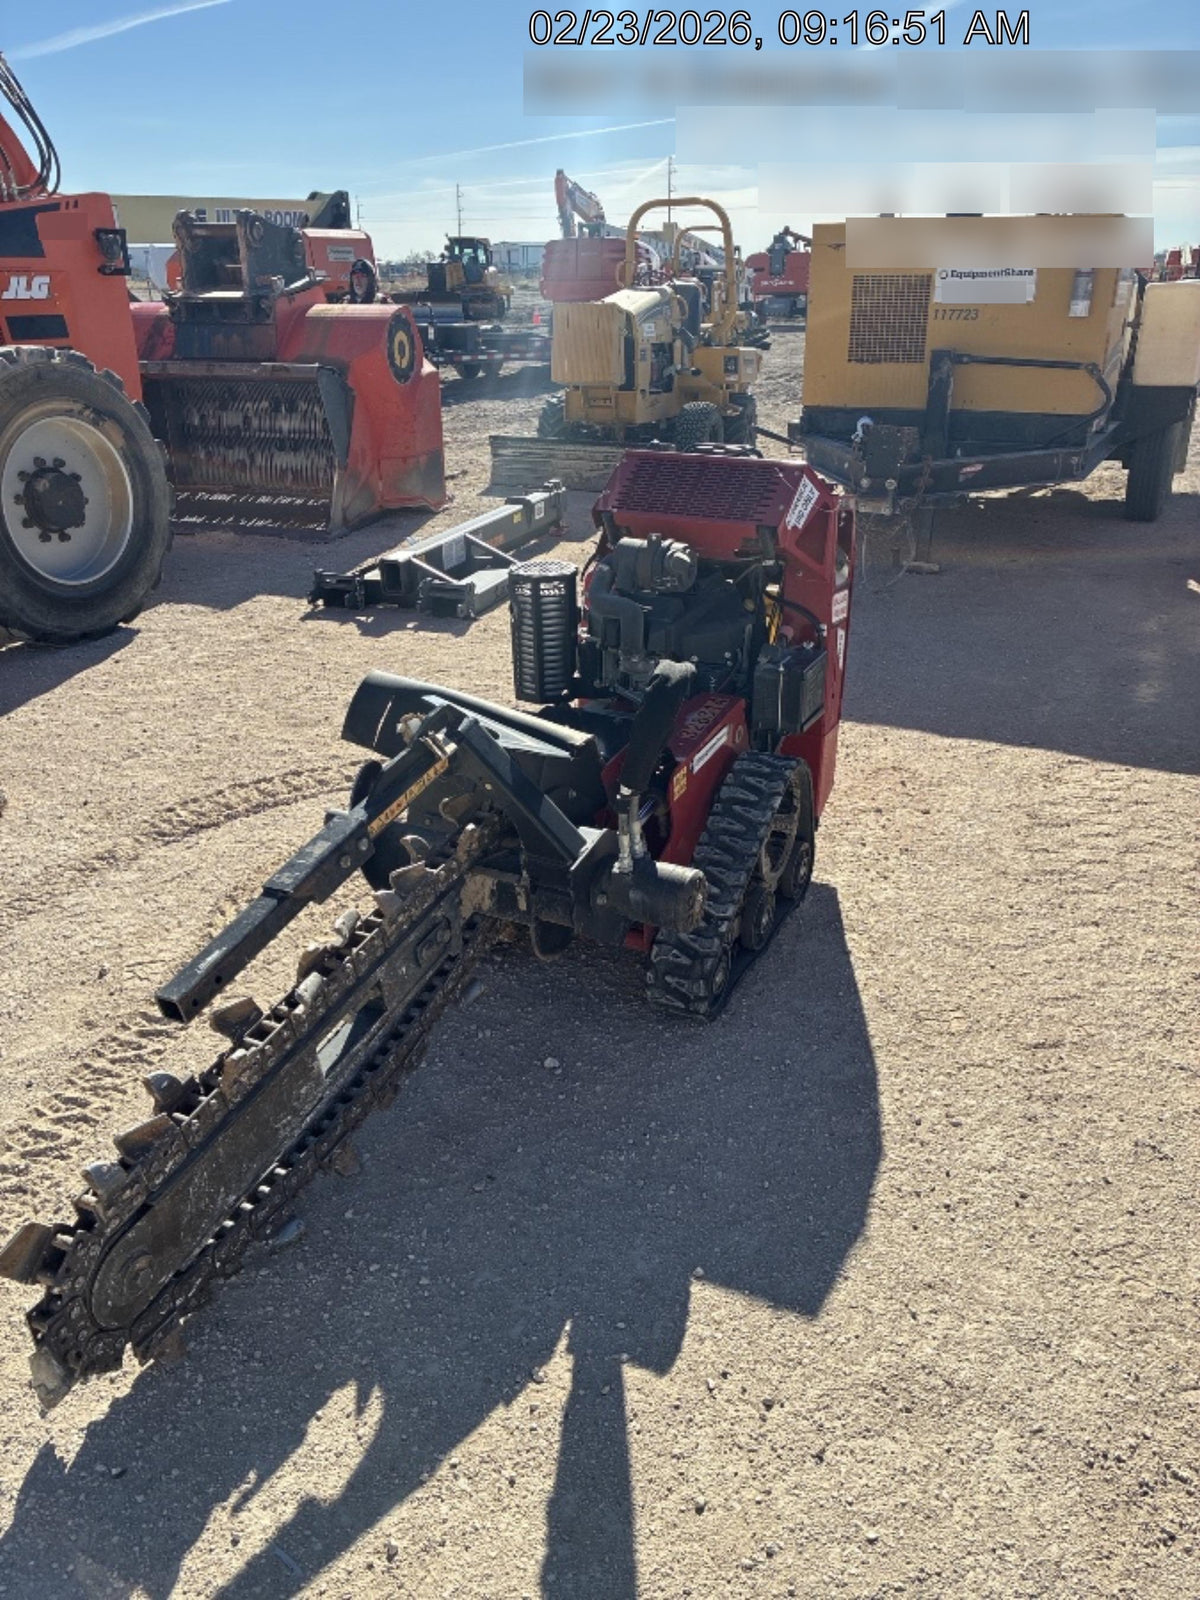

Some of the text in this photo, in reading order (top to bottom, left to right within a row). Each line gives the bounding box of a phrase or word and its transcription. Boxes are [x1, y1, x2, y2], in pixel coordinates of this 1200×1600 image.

[950, 268, 1034, 280] EquipmentShare
[1, 275, 50, 300] JLG
[932, 308, 980, 321] 117723
